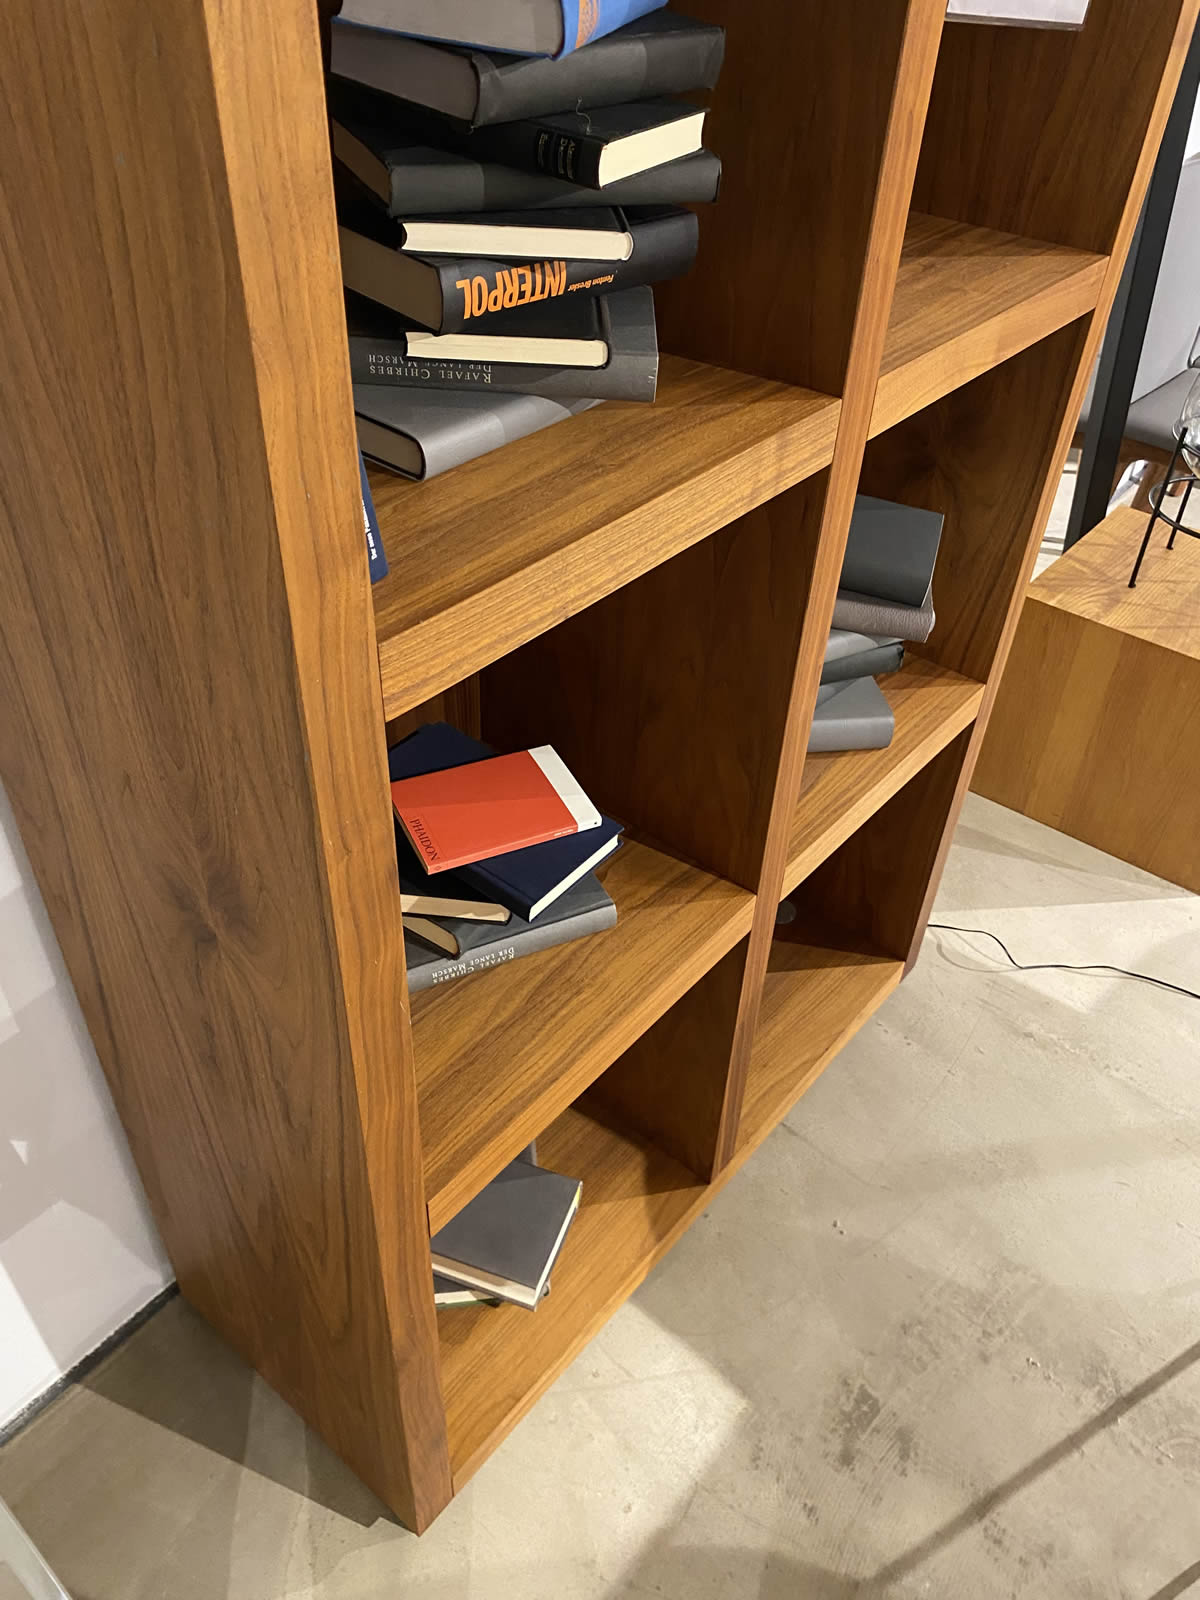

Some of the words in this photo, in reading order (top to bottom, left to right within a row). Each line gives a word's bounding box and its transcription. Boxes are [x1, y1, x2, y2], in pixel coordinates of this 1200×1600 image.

[592, 274, 614, 287] Fenton
[456, 260, 567, 319] INTERPOL
[369, 365, 431, 379] CHIRBES
[439, 369, 492, 384] RAFAEL
[409, 818, 441, 861] PHAIDON
[432, 962, 467, 979] MARSCH
